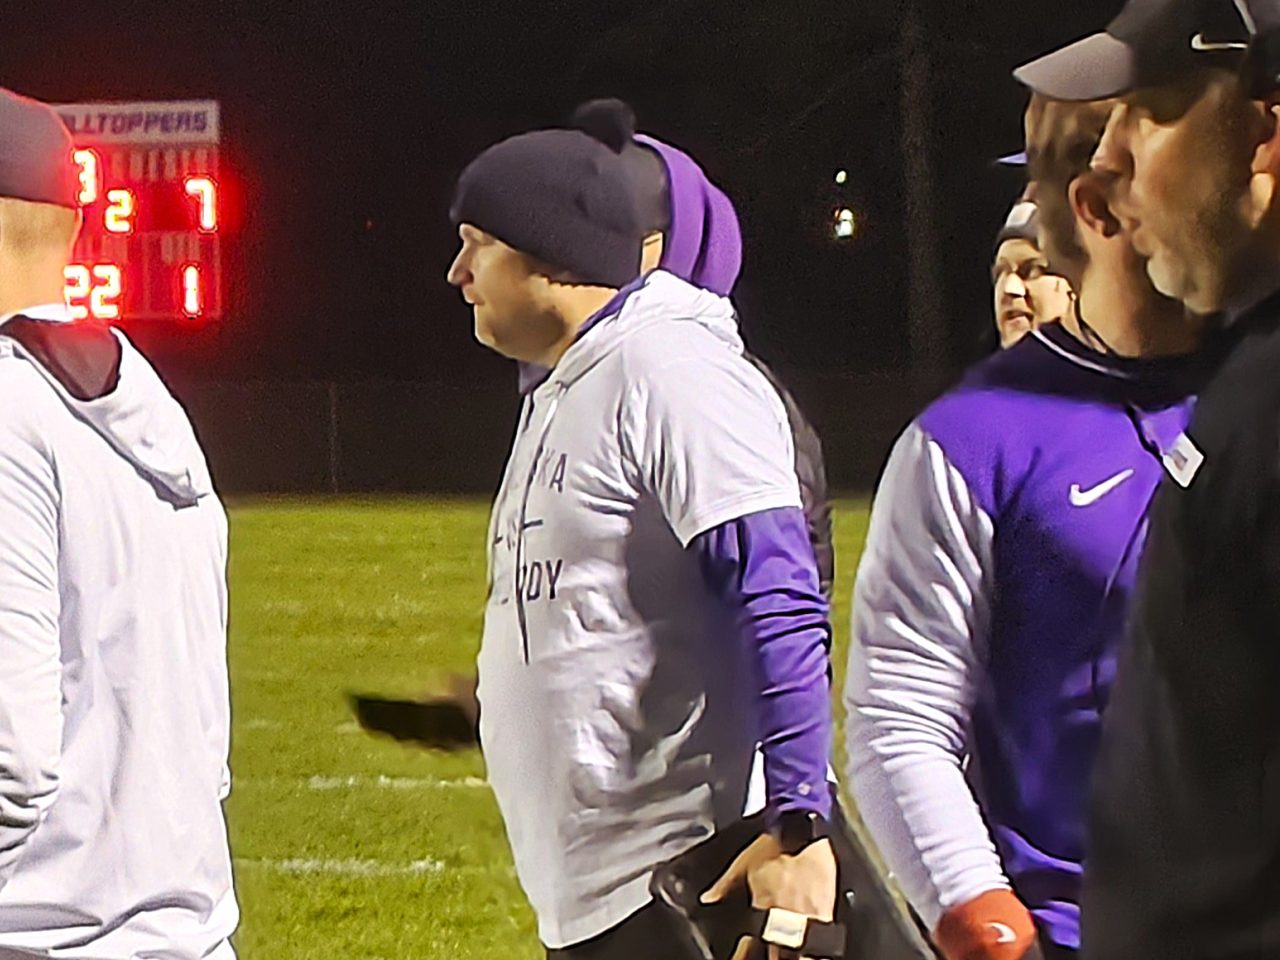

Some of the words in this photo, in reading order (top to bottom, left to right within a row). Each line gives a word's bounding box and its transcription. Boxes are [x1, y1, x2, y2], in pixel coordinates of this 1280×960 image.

[105, 189, 133, 233] 2
[185, 178, 215, 230] 7
[63, 263, 122, 319] 22
[184, 265, 199, 313] 1
